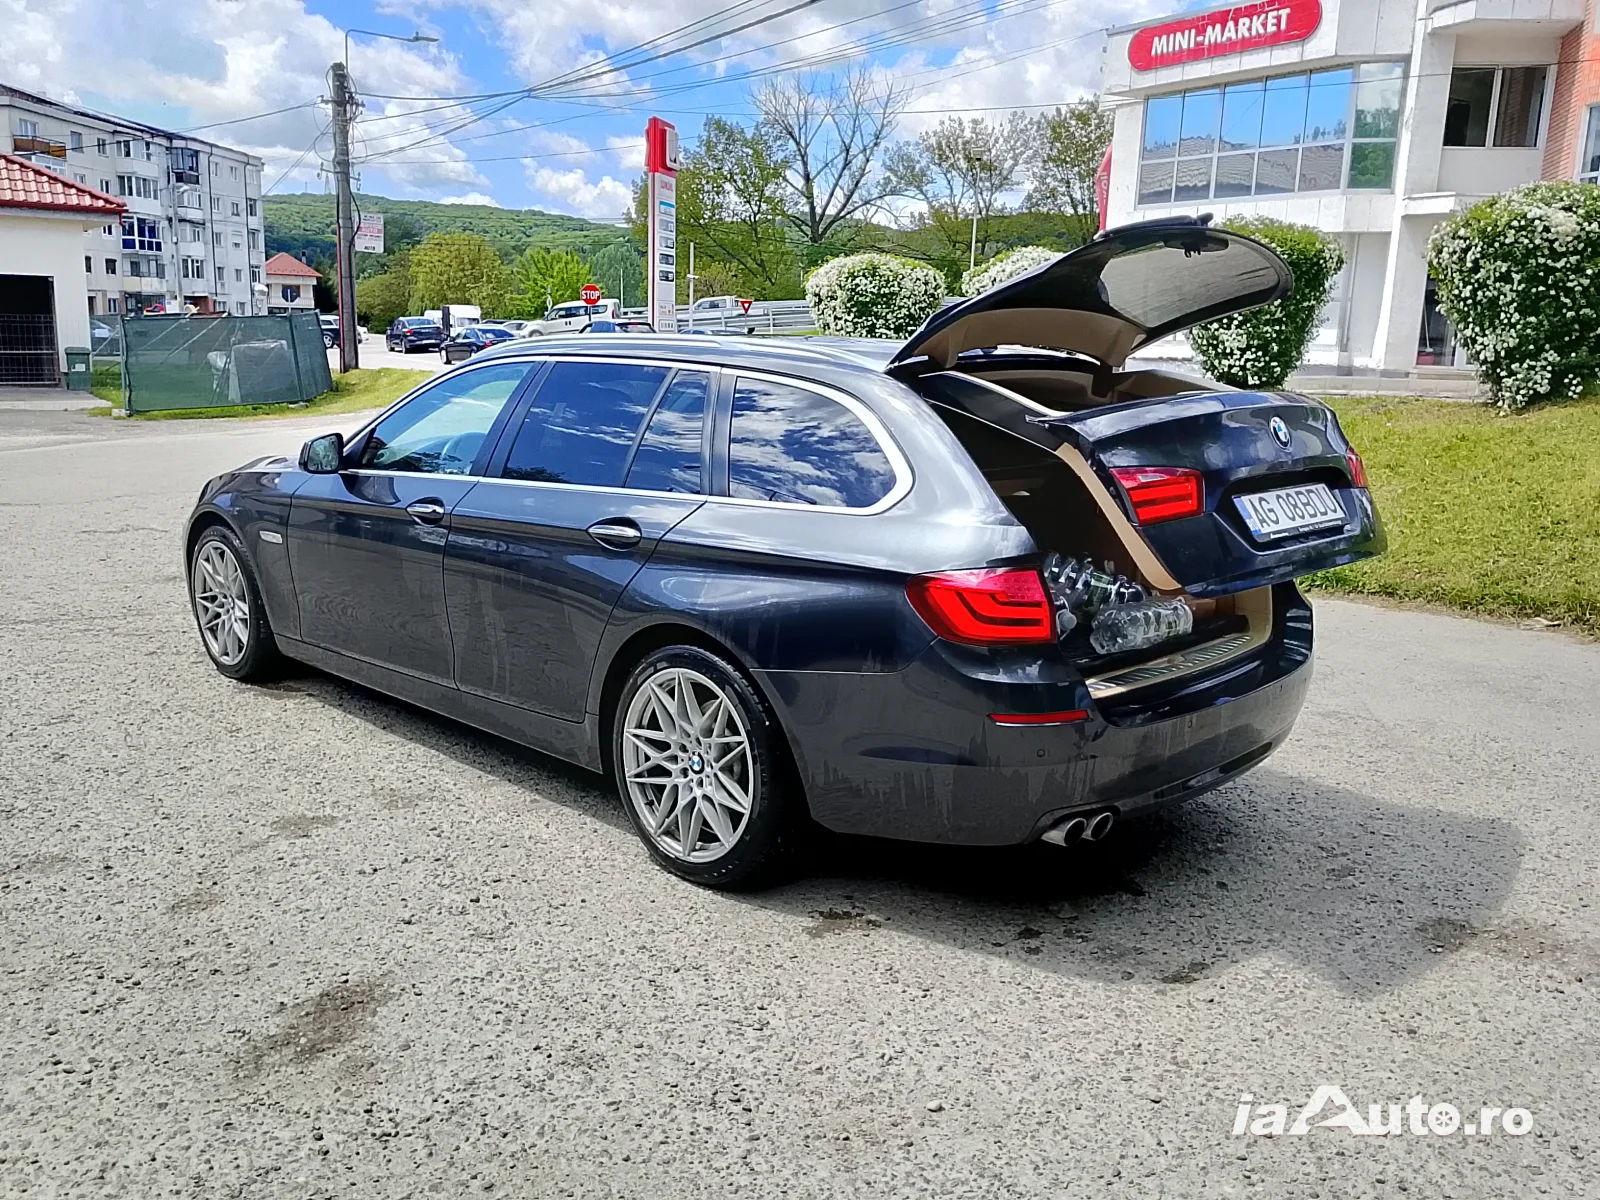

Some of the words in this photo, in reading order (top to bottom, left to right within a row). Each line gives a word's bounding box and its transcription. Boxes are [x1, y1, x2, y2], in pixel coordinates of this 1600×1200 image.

[1151, 8, 1291, 56] MINI-MARKET
[581, 290, 600, 300] STOP
[1248, 496, 1280, 528] AG
[1275, 486, 1338, 522] 08BDU
